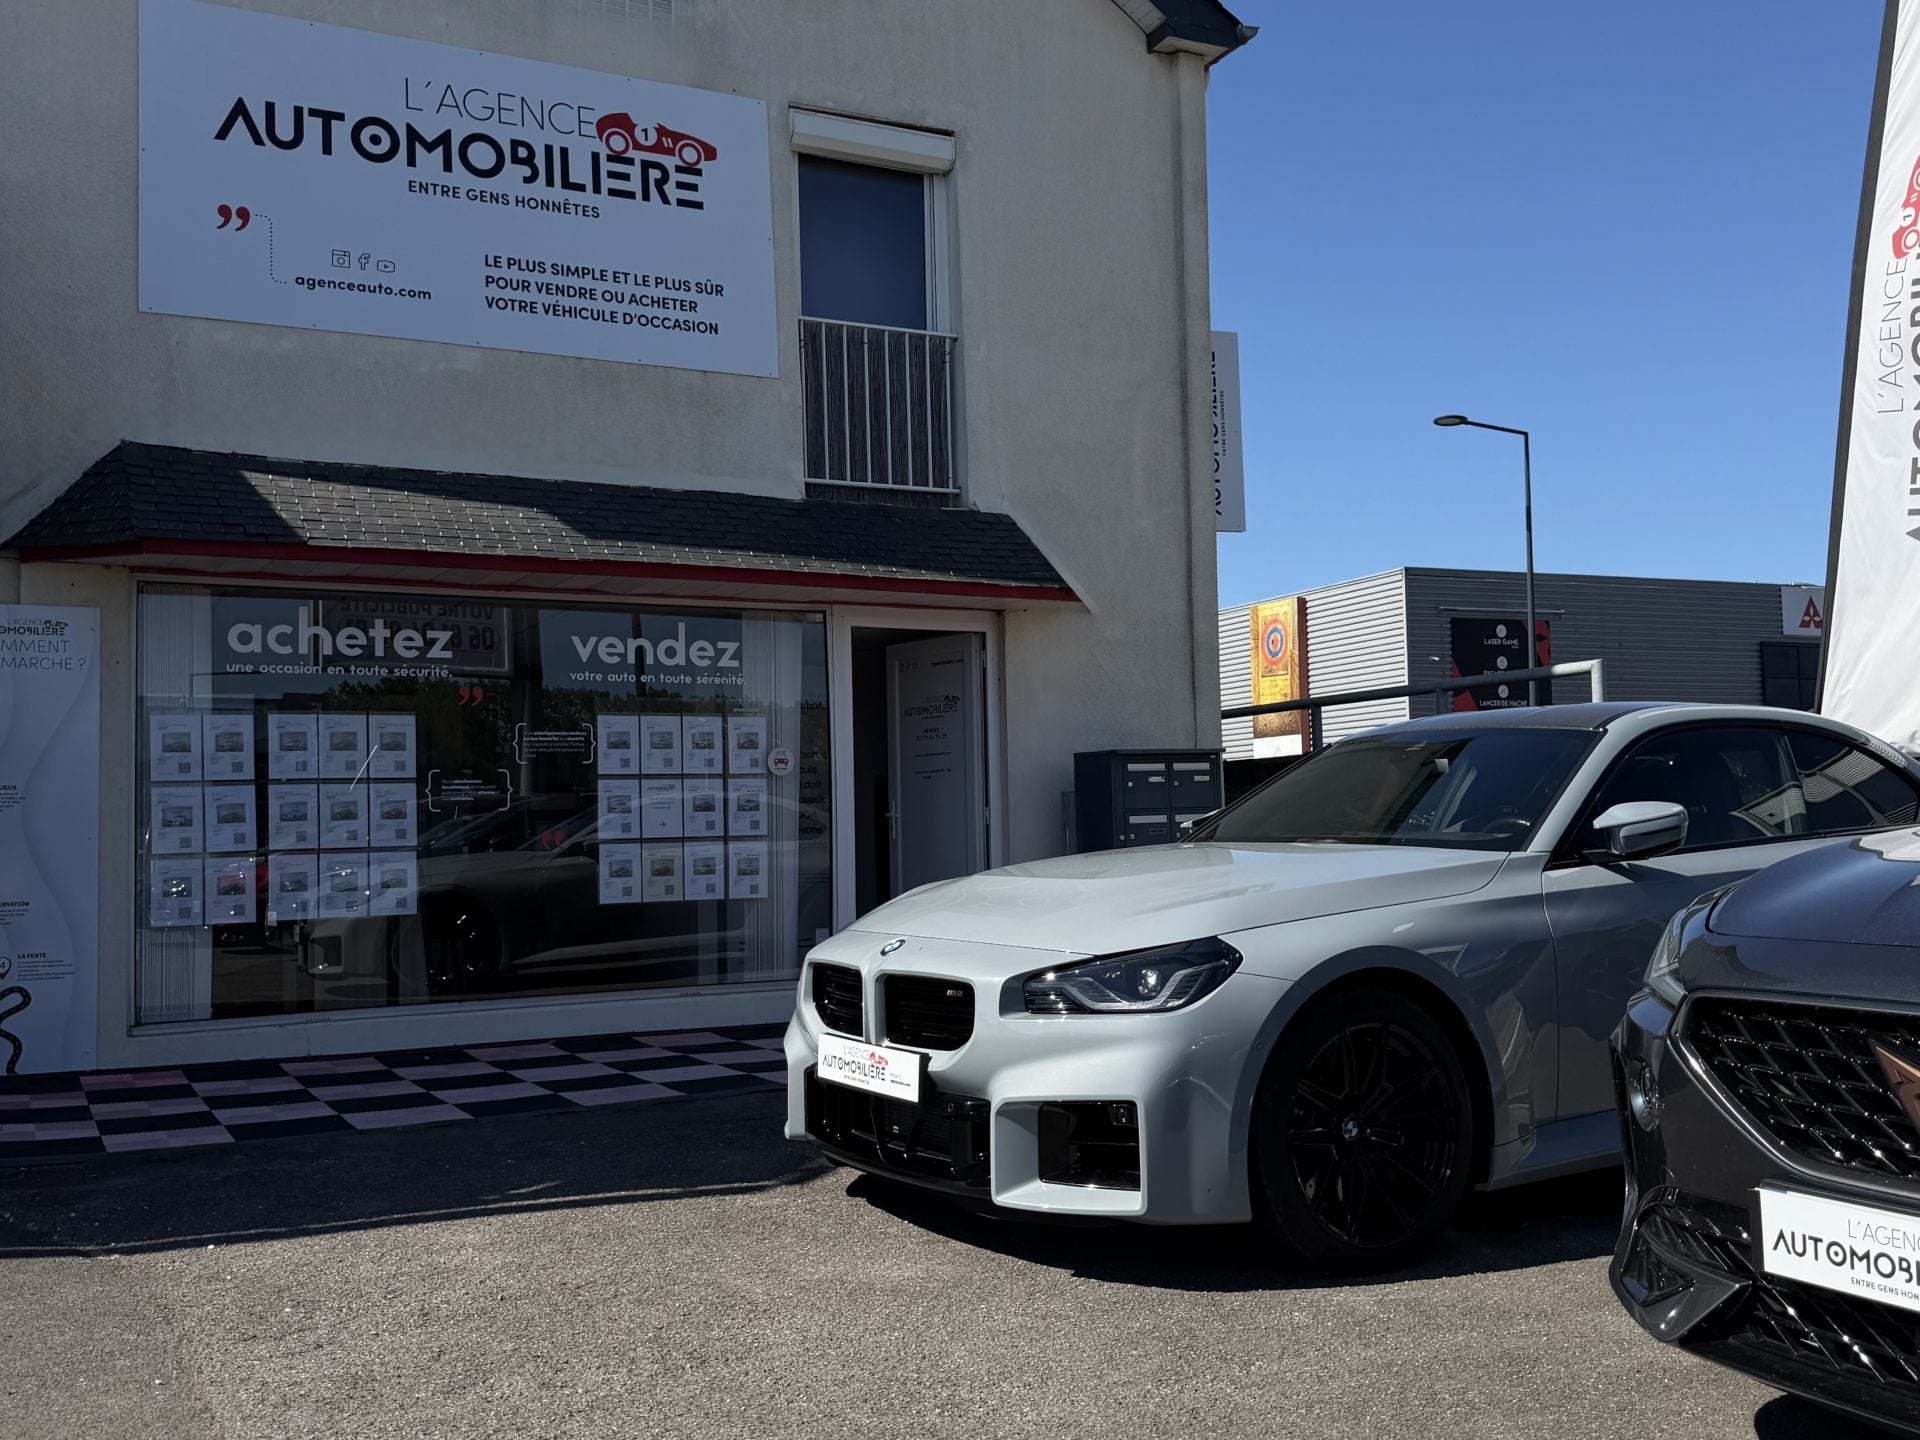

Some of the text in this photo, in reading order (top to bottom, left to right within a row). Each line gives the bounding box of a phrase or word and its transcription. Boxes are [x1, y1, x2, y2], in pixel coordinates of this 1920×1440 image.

[404, 77, 597, 137] L'AGENCE
[408, 179, 600, 219] ENTRE GENS HONNÊTES
[295, 272, 432, 300] agenceauto.com
[485, 254, 724, 297] LE PLUS SIMPLE ET LE PLUS SÛR
[485, 275, 698, 313] POUR VENDRE OU ACHETER
[485, 296, 719, 335] VOTRE VÉHICULE D'OCCASION
[1878, 258, 1907, 414] L'AGENCE
[227, 606, 453, 659] achetez
[570, 622, 740, 667] vendez
[1, 656, 87, 671] MARCHE ?
[226, 662, 254, 673] une
[259, 661, 322, 675] occasion
[327, 666, 345, 676] en
[350, 664, 389, 677] toute
[570, 671, 603, 682] votre
[607, 672, 637, 682] auto
[640, 674, 656, 684] en
[659, 673, 692, 684] toute
[1851, 1277, 1876, 1290] ENTRE
[1877, 1284, 1899, 1296] GENS
